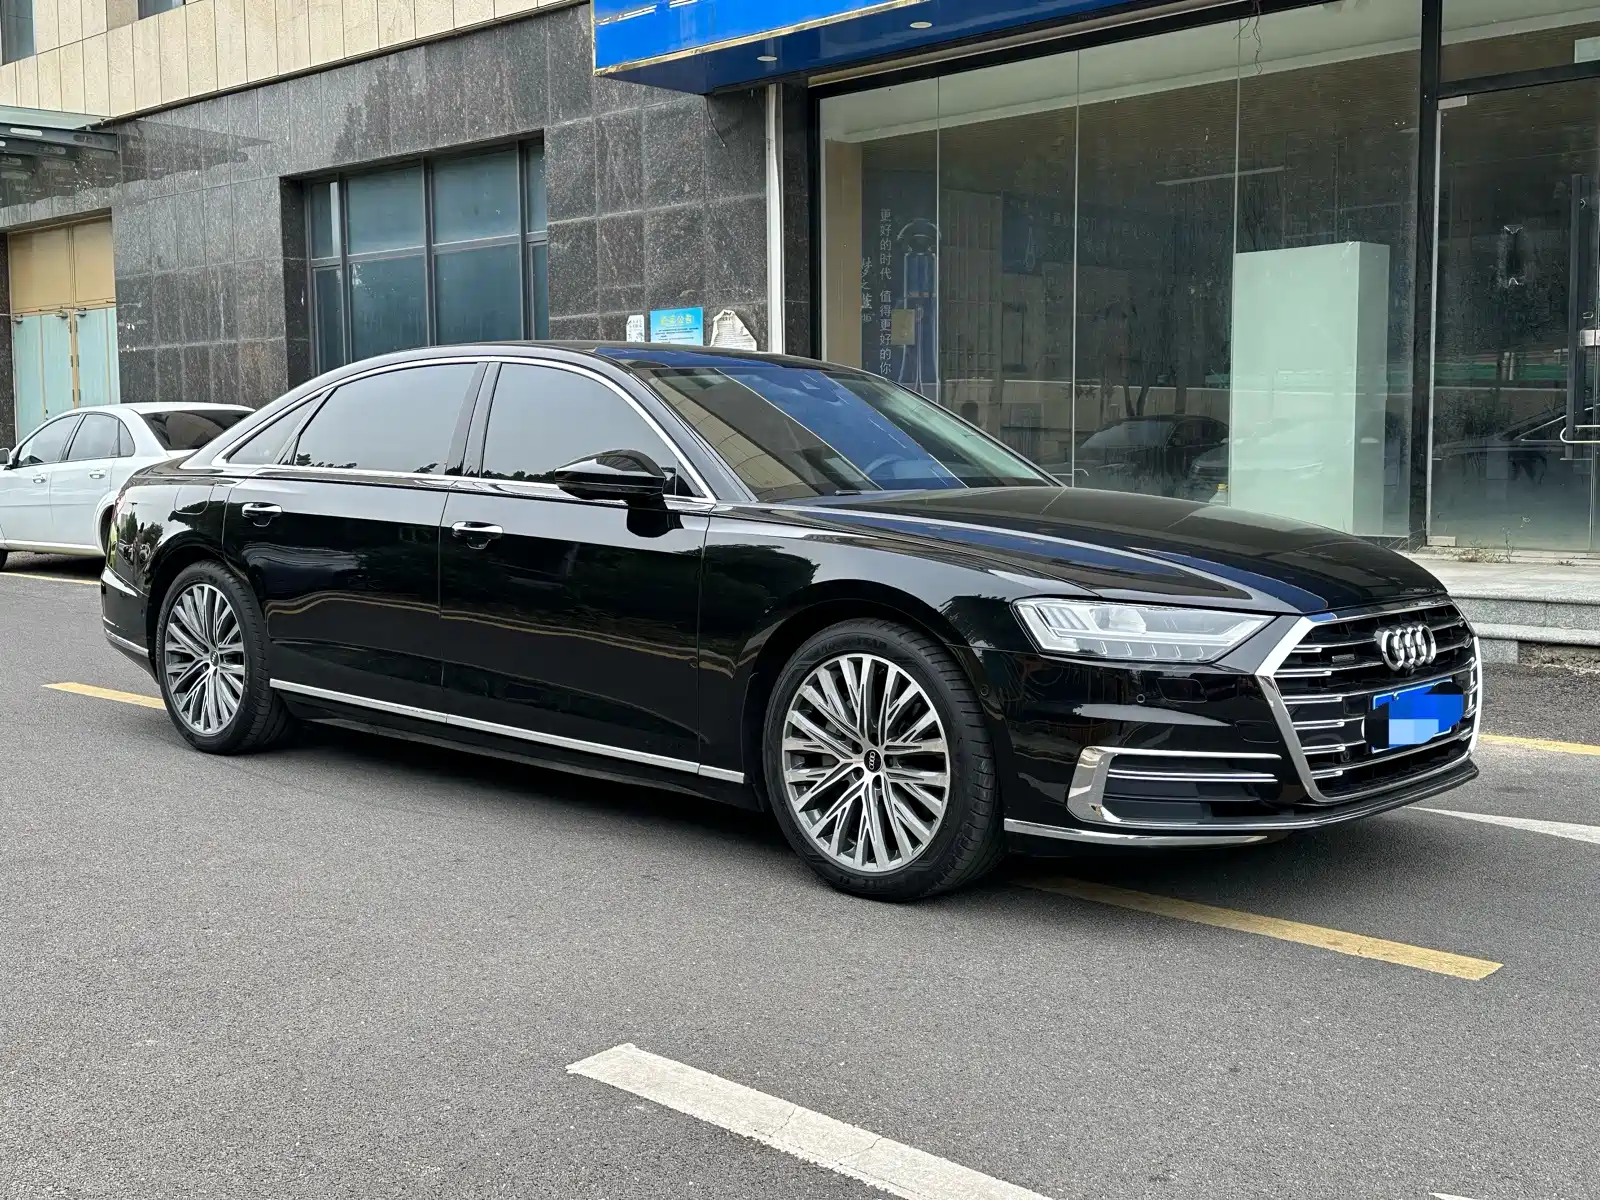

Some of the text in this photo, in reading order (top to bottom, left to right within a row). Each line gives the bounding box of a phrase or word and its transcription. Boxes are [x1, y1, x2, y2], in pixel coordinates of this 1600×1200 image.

[879, 208, 892, 375] 更好的时代 值得更好的你
